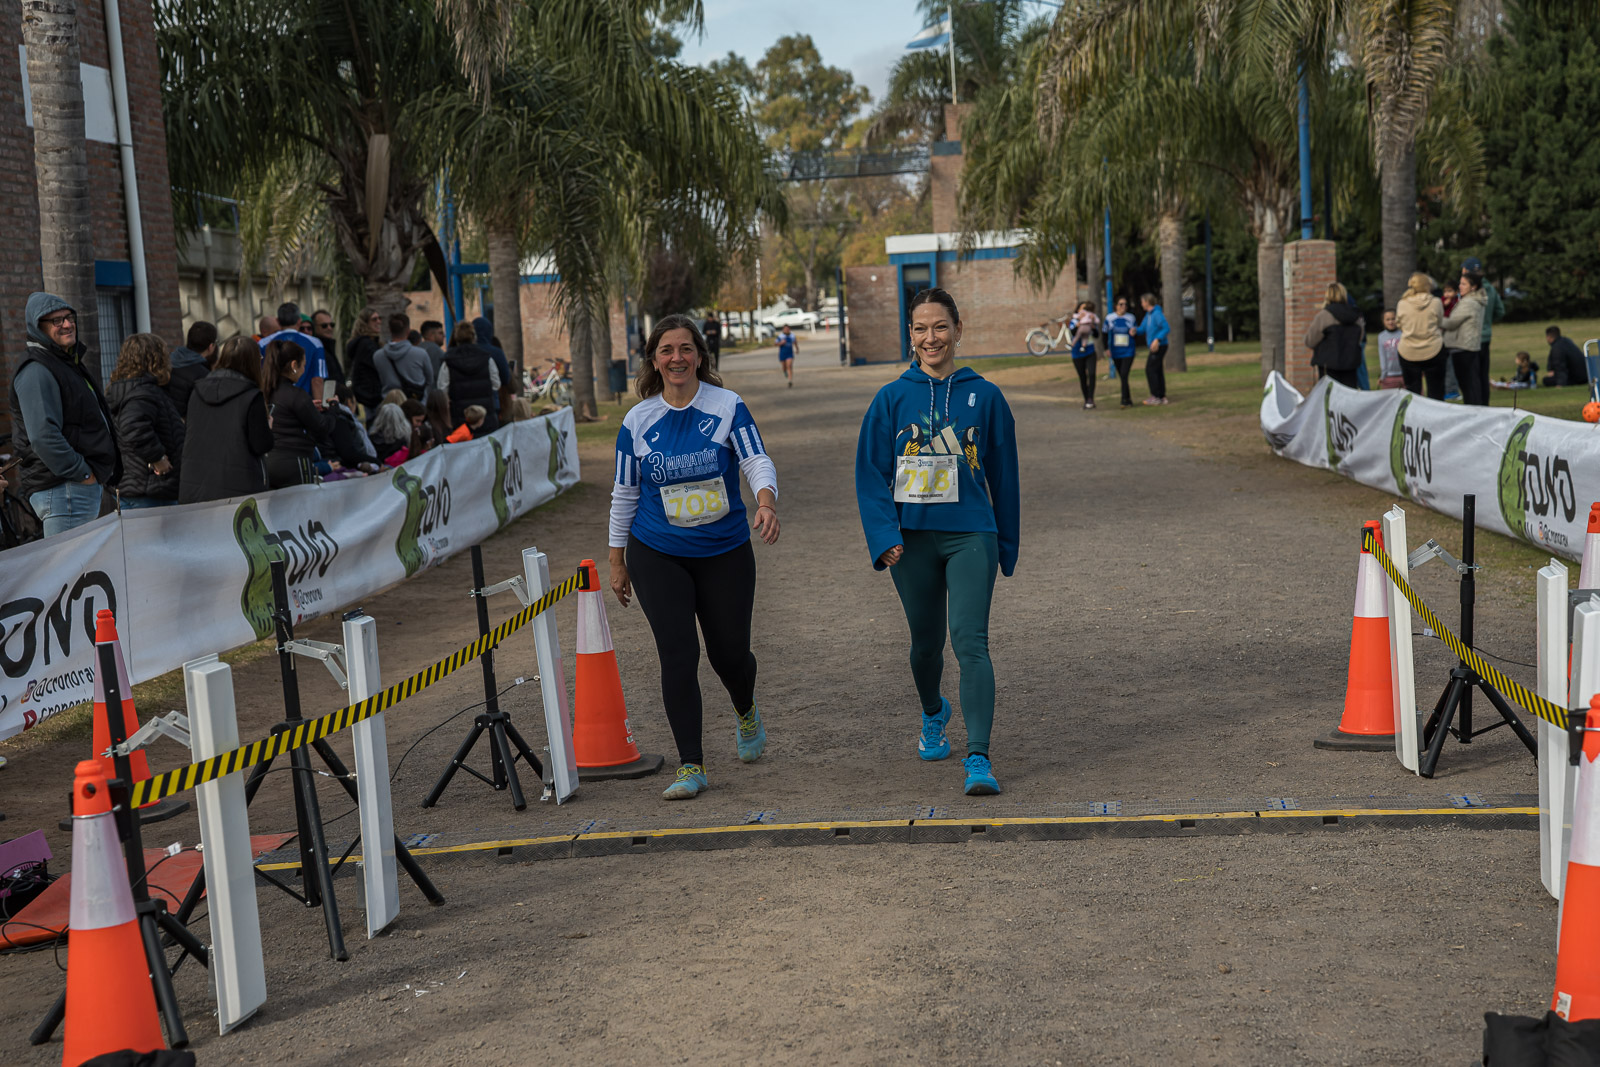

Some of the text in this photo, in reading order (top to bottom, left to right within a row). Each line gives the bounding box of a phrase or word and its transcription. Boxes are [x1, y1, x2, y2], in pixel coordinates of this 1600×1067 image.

[648, 451, 666, 484] 3
[904, 469, 949, 492] 718
[669, 490, 723, 519] 708
[0, 570, 117, 679] ONO
